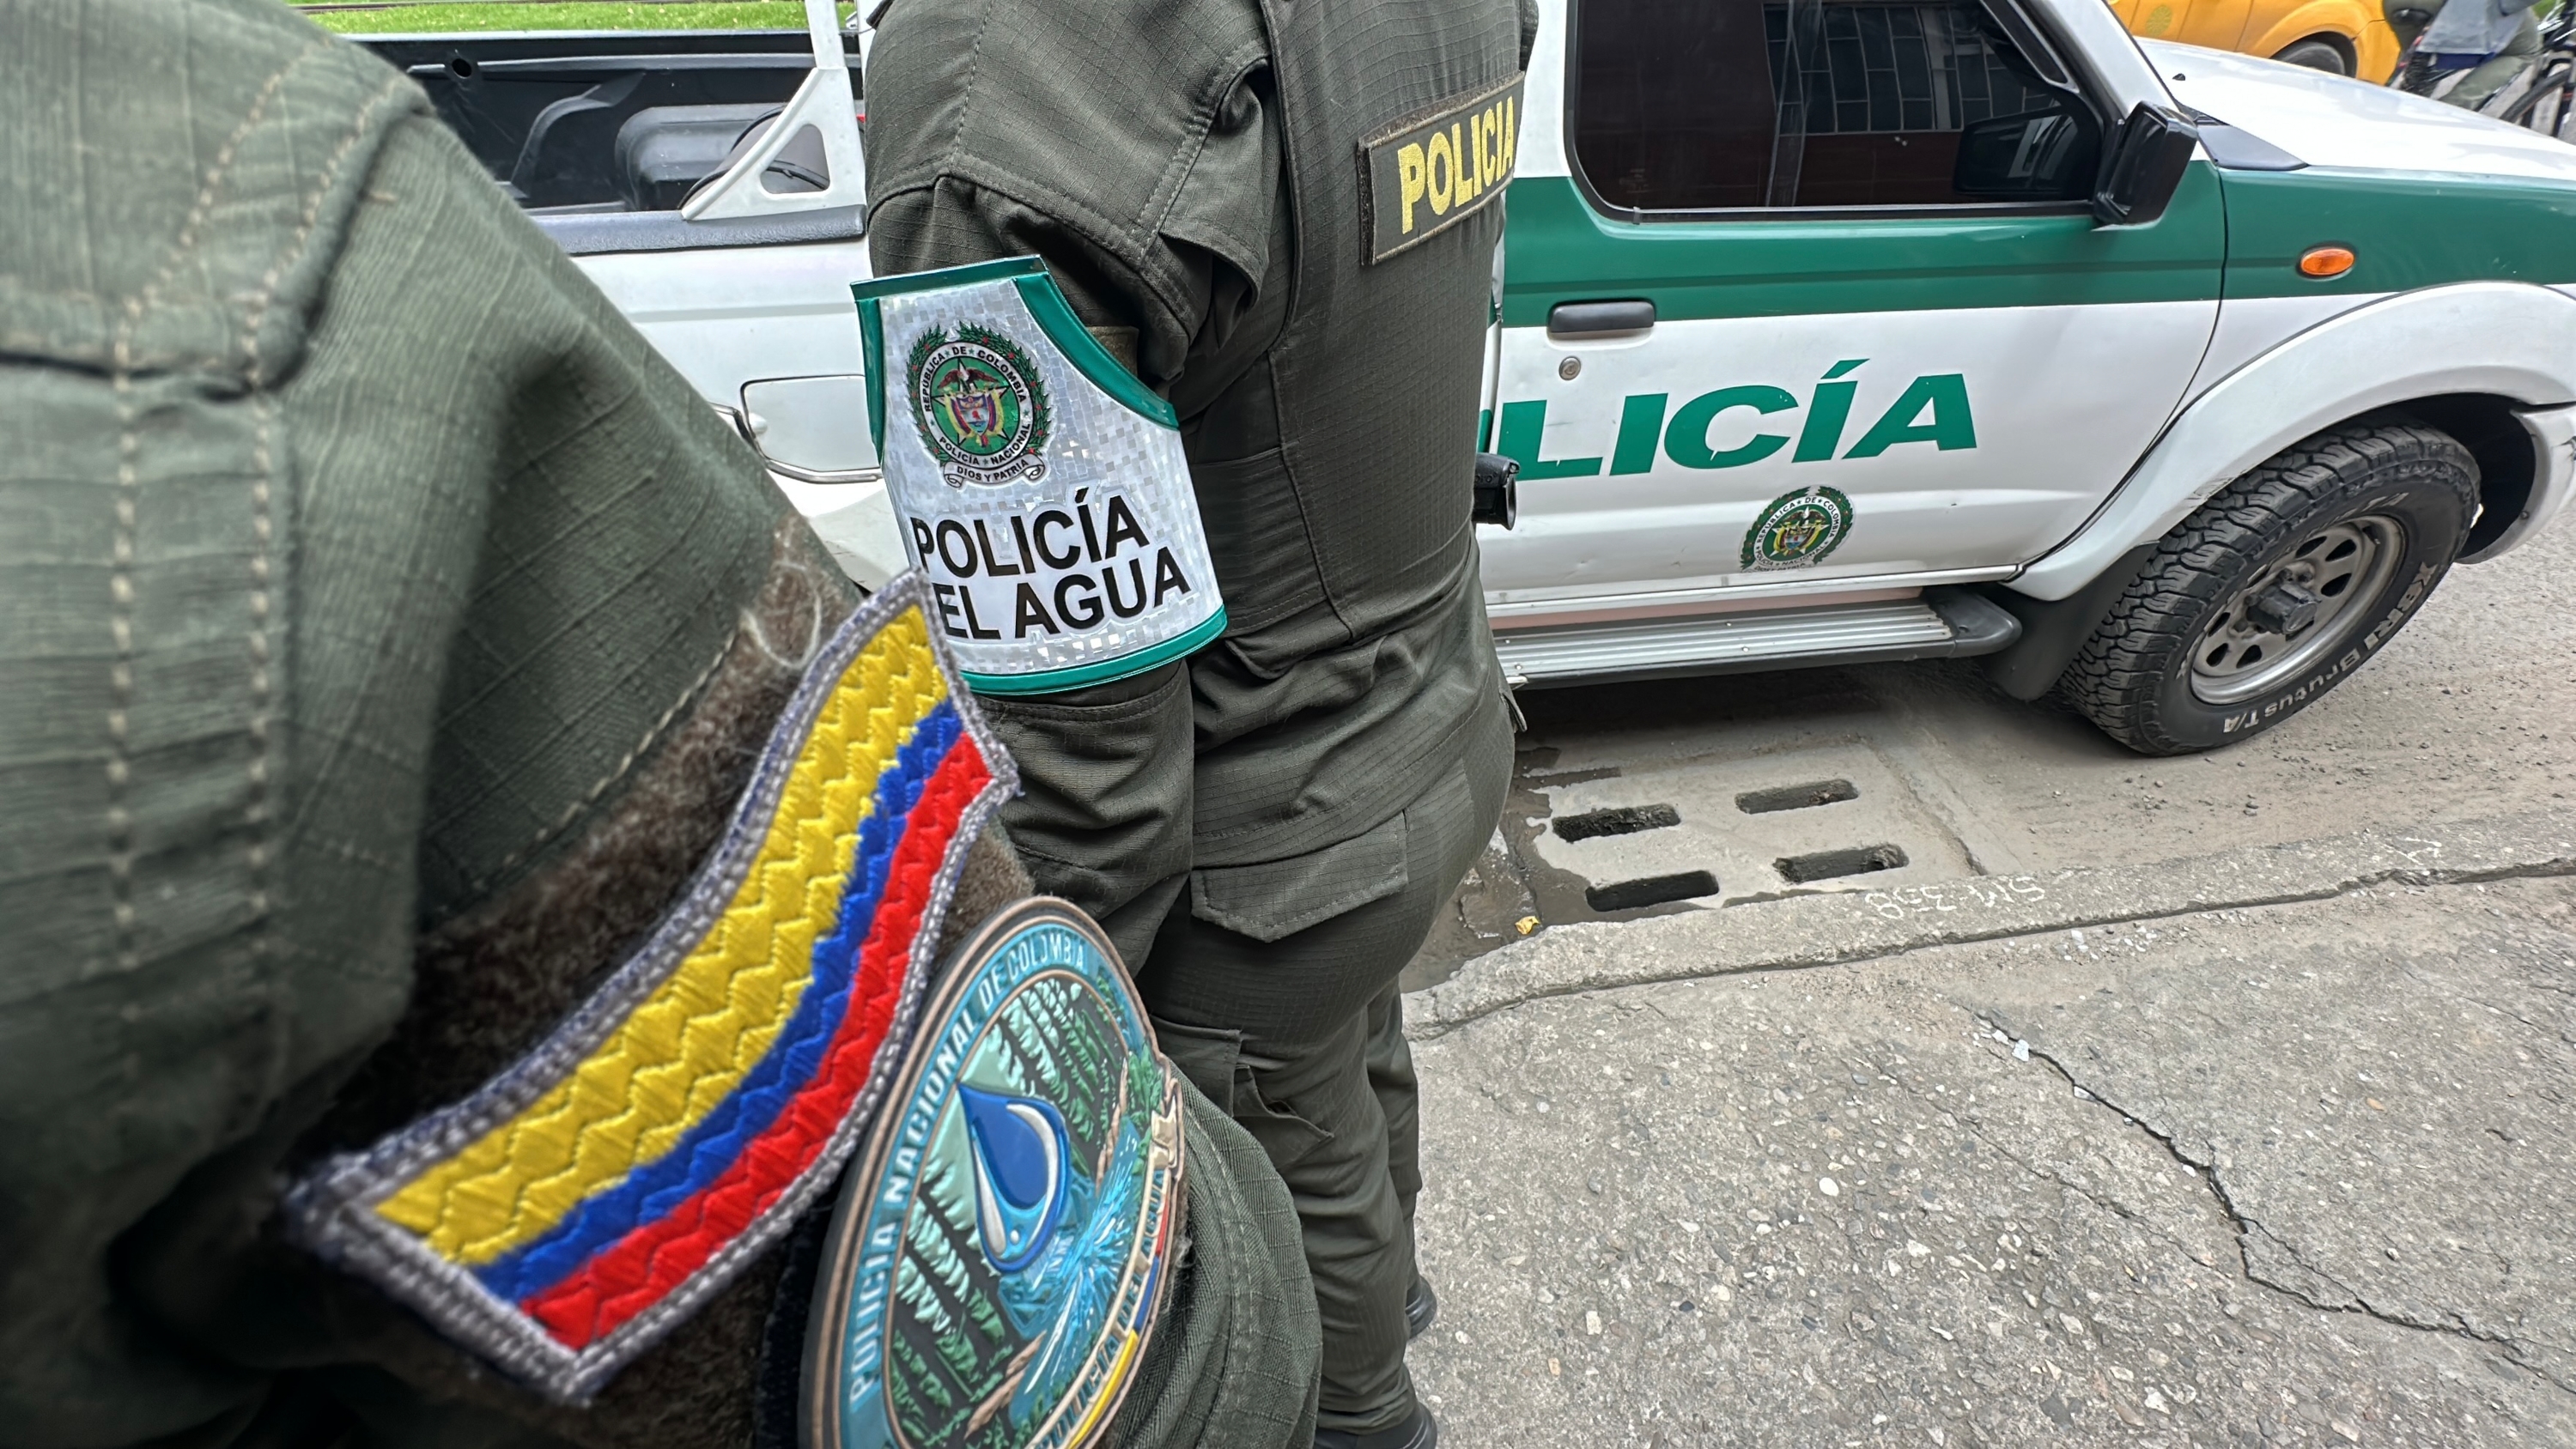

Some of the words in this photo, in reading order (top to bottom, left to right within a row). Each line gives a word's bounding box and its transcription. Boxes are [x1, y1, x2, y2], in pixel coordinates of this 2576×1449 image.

[1398, 96, 1514, 234] POLICIA
[951, 346, 967, 355] DE
[977, 350, 1027, 403] COLOMBIA
[939, 436, 980, 465] POLICÍA
[990, 423, 1030, 465] NACIONAL
[1478, 359, 1977, 481] LICÍA
[957, 466, 981, 481] DIOS
[993, 458, 1029, 480] PATRIA
[910, 487, 1150, 579] POLICÍA
[1823, 500, 1841, 537] COLOMBIA
[1782, 544, 1826, 566] NACIONAL
[933, 583, 1001, 640] EL
[1015, 547, 1191, 638] AGUA
[2264, 648, 2360, 717] Brutus
[2223, 712, 2260, 733] T/A
[883, 1009, 976, 1203] NACIONAL
[978, 964, 1006, 1013] DE
